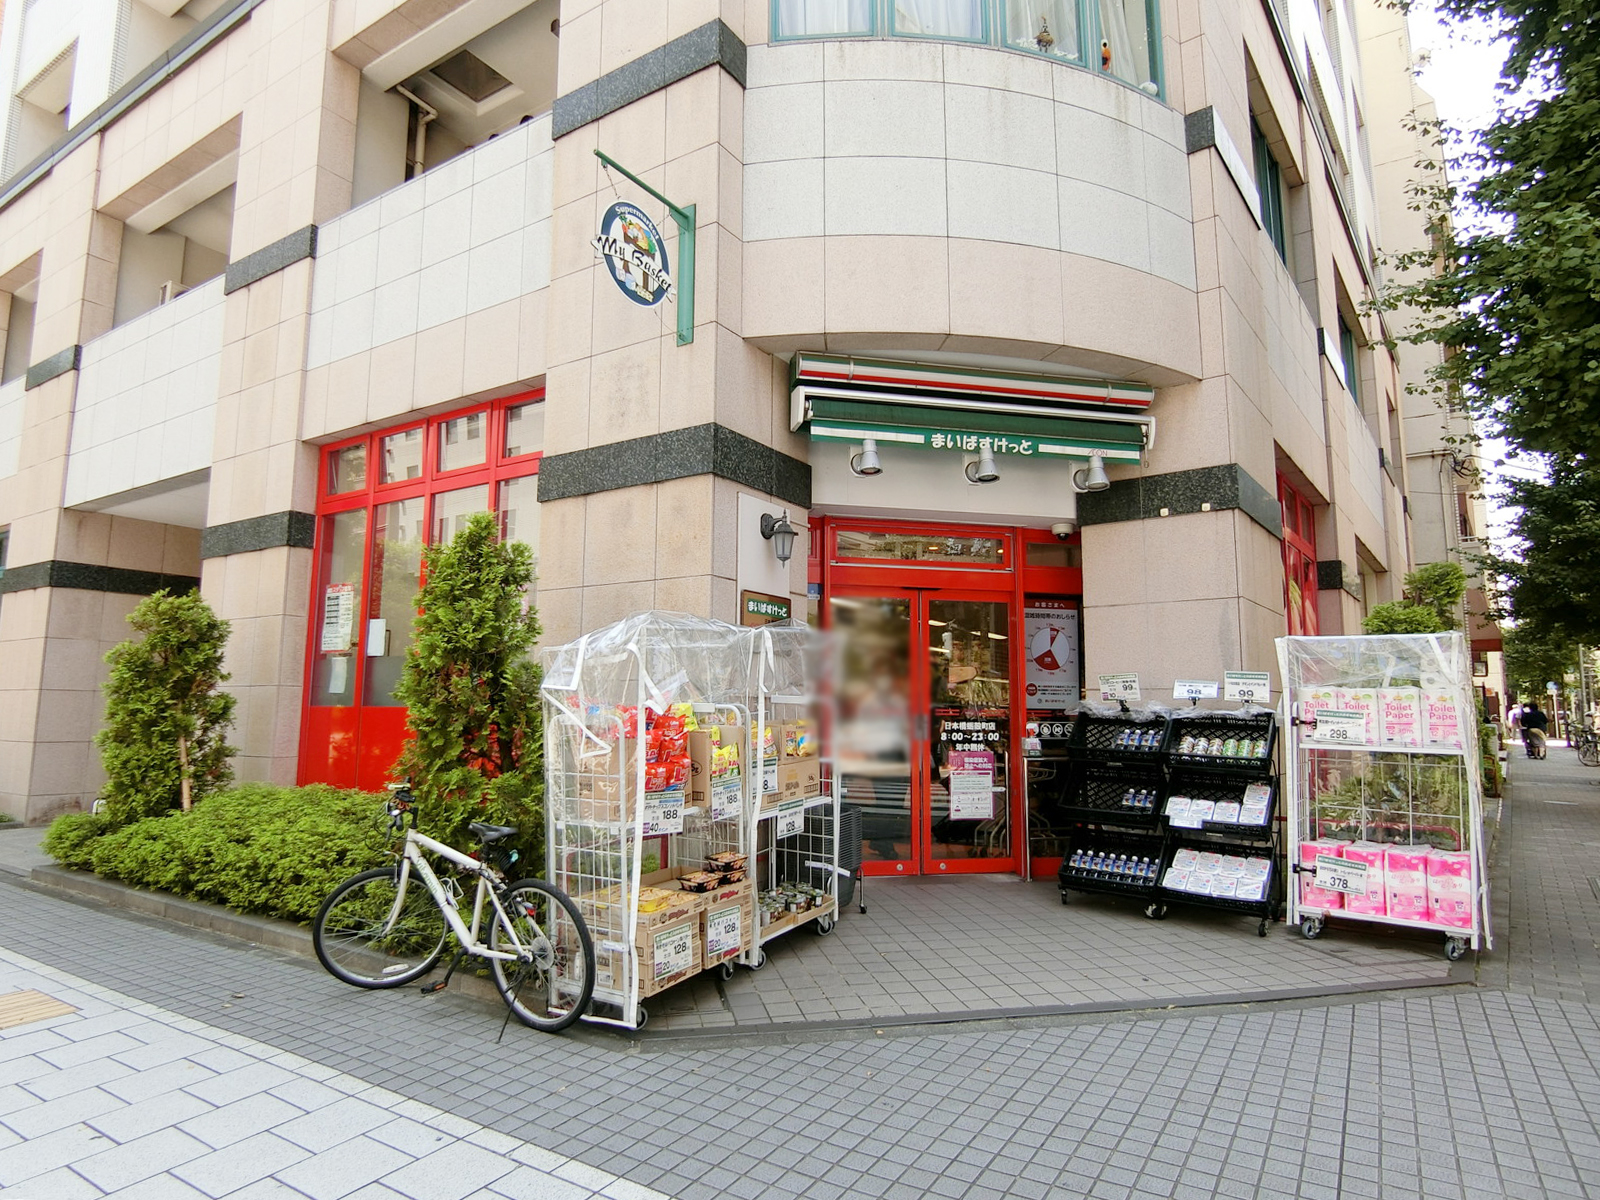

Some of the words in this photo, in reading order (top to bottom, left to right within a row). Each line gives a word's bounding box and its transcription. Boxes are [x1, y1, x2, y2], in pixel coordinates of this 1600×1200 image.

[614, 205, 660, 240] Supermarket
[597, 236, 626, 260] My
[631, 249, 672, 293] Basket
[930, 433, 1033, 456] まいばすけっと
[747, 600, 788, 617] まいばすけっと
[1122, 683, 1134, 692] 99
[1187, 688, 1202, 696] 98
[1238, 689, 1254, 699] 99
[1303, 701, 1329, 709] Toilet
[1344, 702, 1370, 710] Toilet
[1385, 703, 1412, 711] Toilet
[1385, 711, 1414, 720] Paper
[1329, 728, 1348, 740] 298
[726, 793, 738, 804] 188
[662, 809, 678, 820] 188
[649, 822, 659, 833] 40
[1329, 876, 1349, 889] 378
[724, 922, 736, 934] 128
[674, 941, 687, 955] 128
[662, 960, 671, 971] 20
